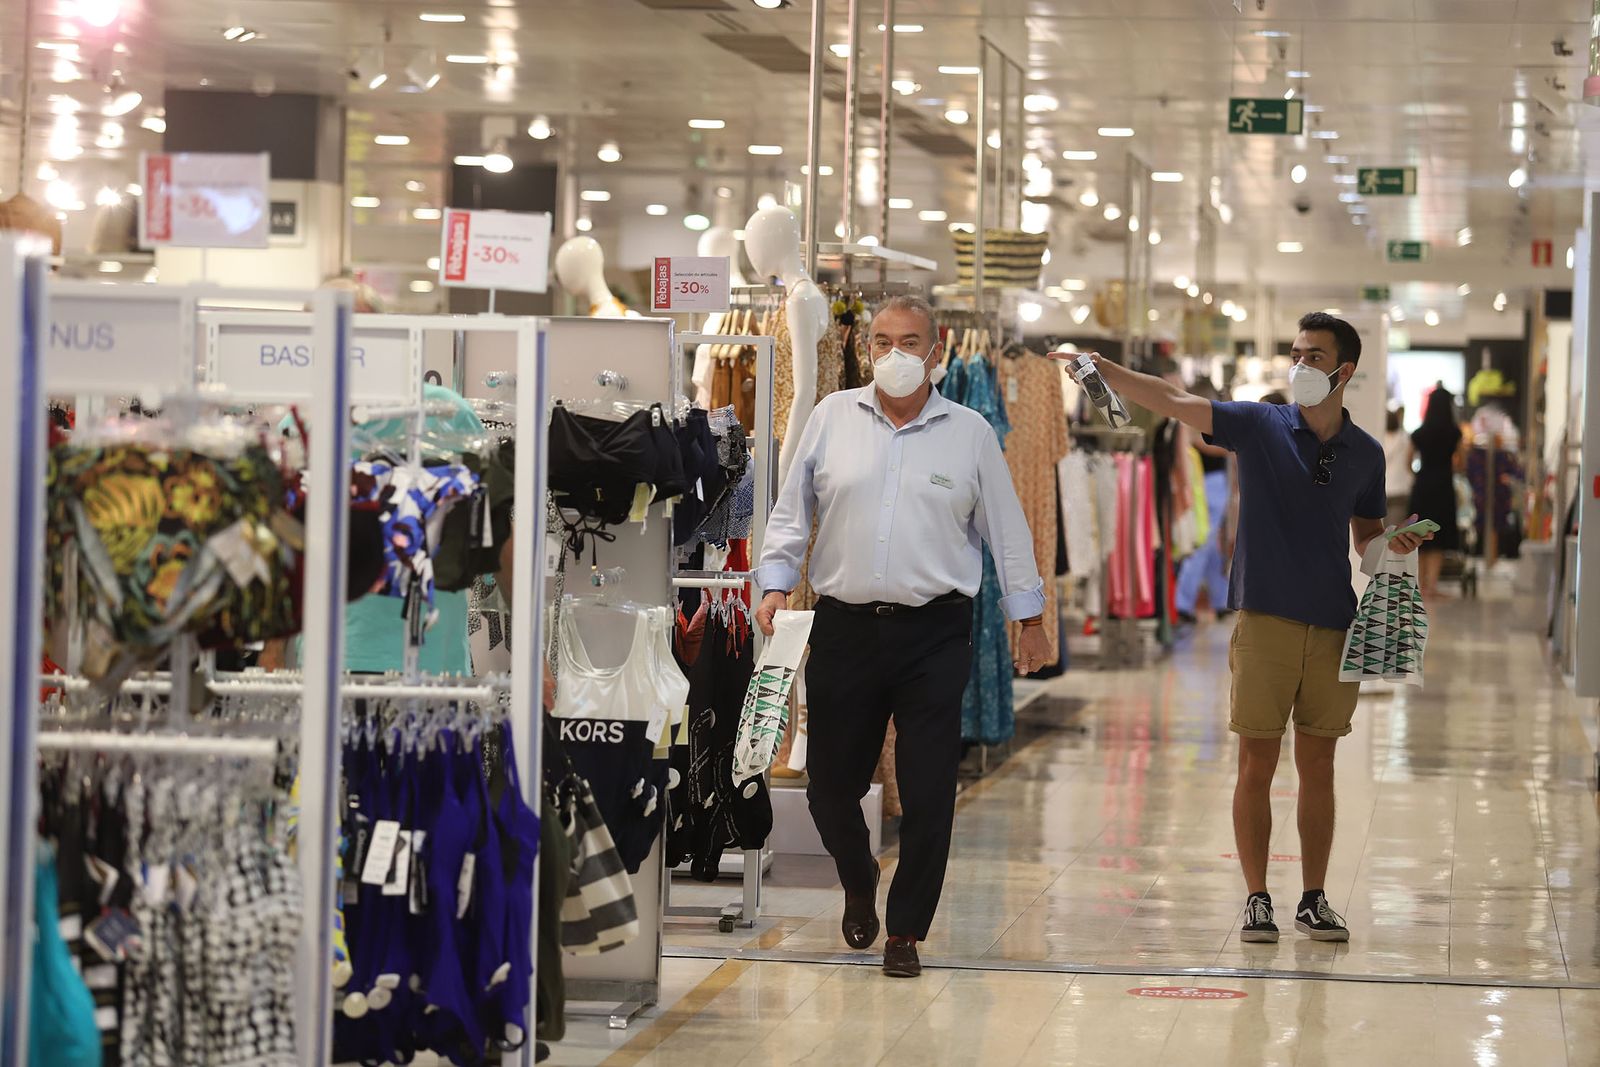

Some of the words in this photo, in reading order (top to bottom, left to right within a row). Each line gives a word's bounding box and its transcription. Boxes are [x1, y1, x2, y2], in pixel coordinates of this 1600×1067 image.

[473, 245, 519, 264] -30%
[658, 265, 669, 304] rebajas
[674, 281, 709, 294] -30%
[50, 321, 114, 351] NUS
[260, 344, 366, 368] BASR
[559, 720, 625, 744] KORS
